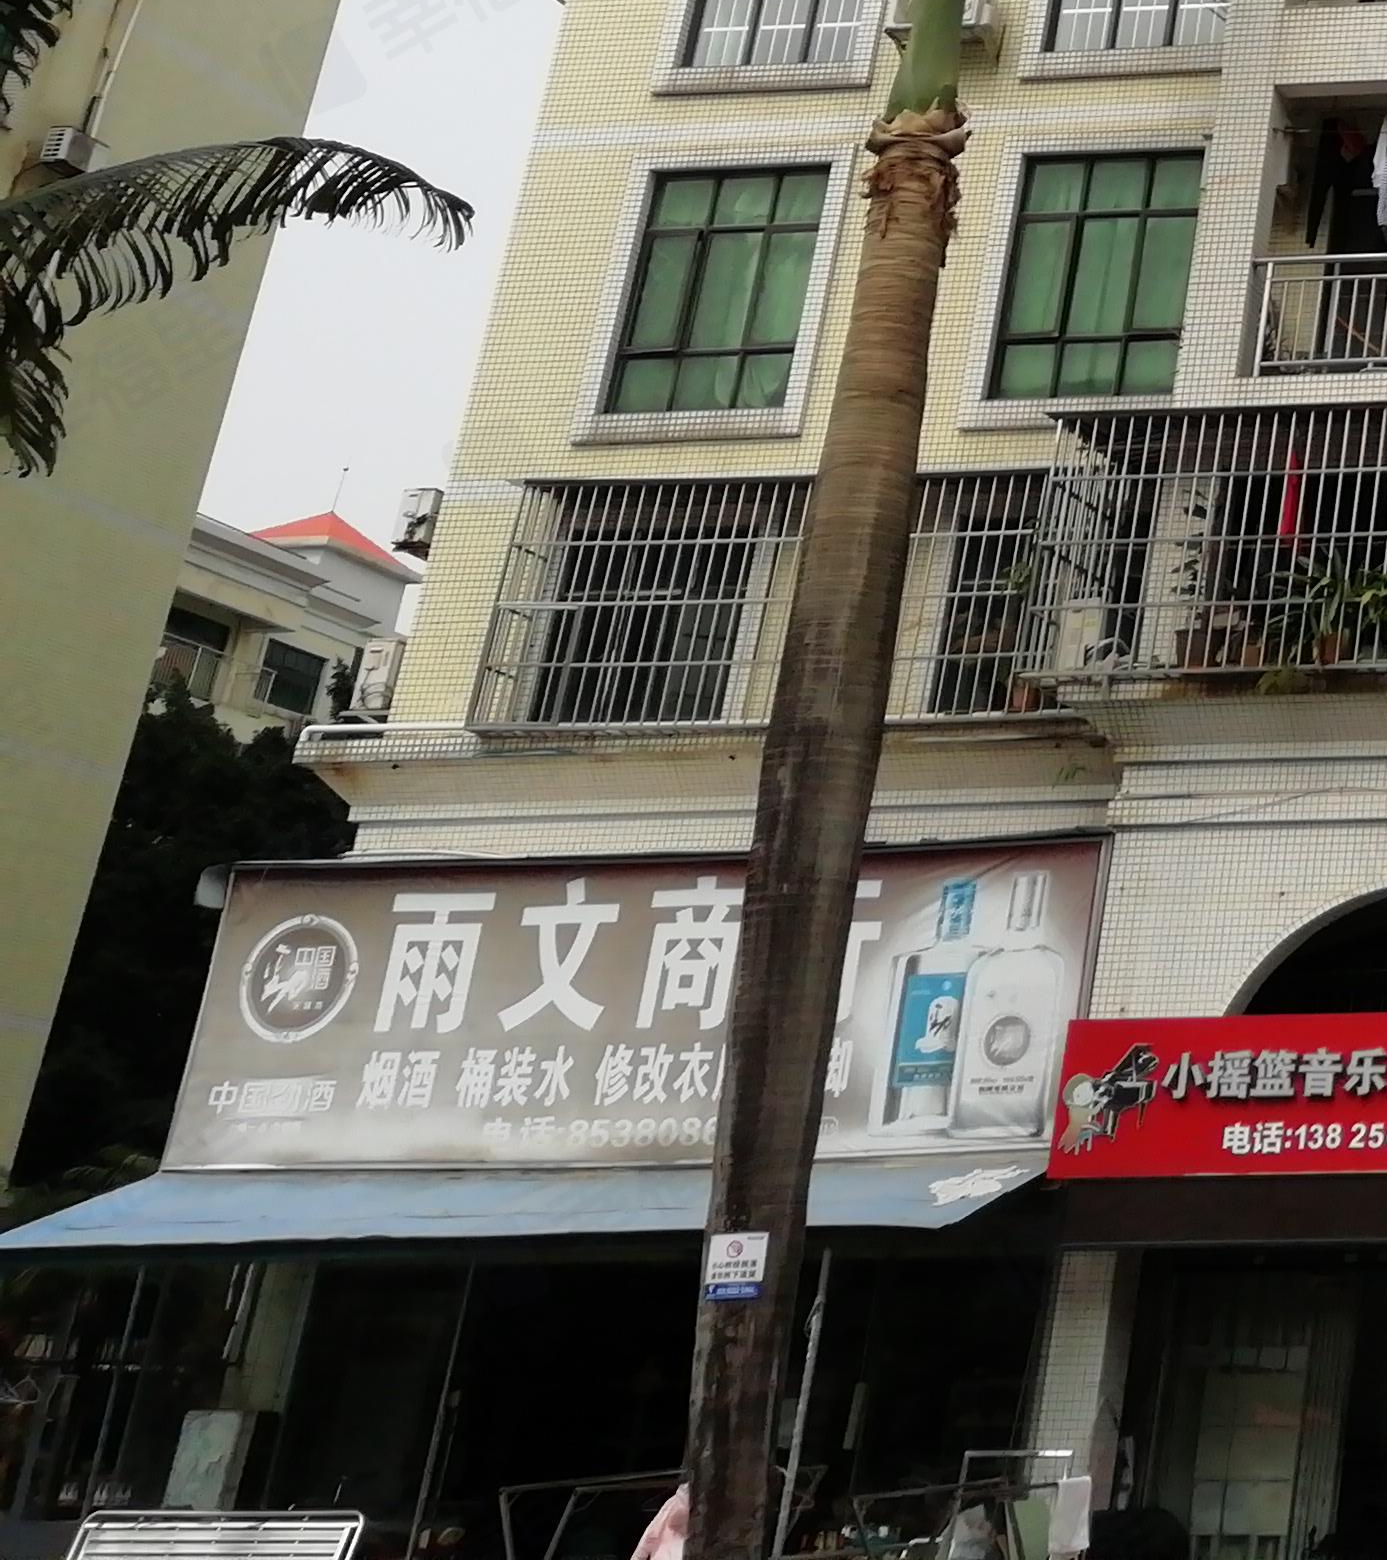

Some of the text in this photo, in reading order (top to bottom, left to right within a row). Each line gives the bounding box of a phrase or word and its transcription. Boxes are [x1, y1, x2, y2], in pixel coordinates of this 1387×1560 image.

[356, 1050, 441, 1113] 烟酒
[456, 1045, 574, 1108] 桶装水
[1221, 1121, 1342, 1155] 电话:138
